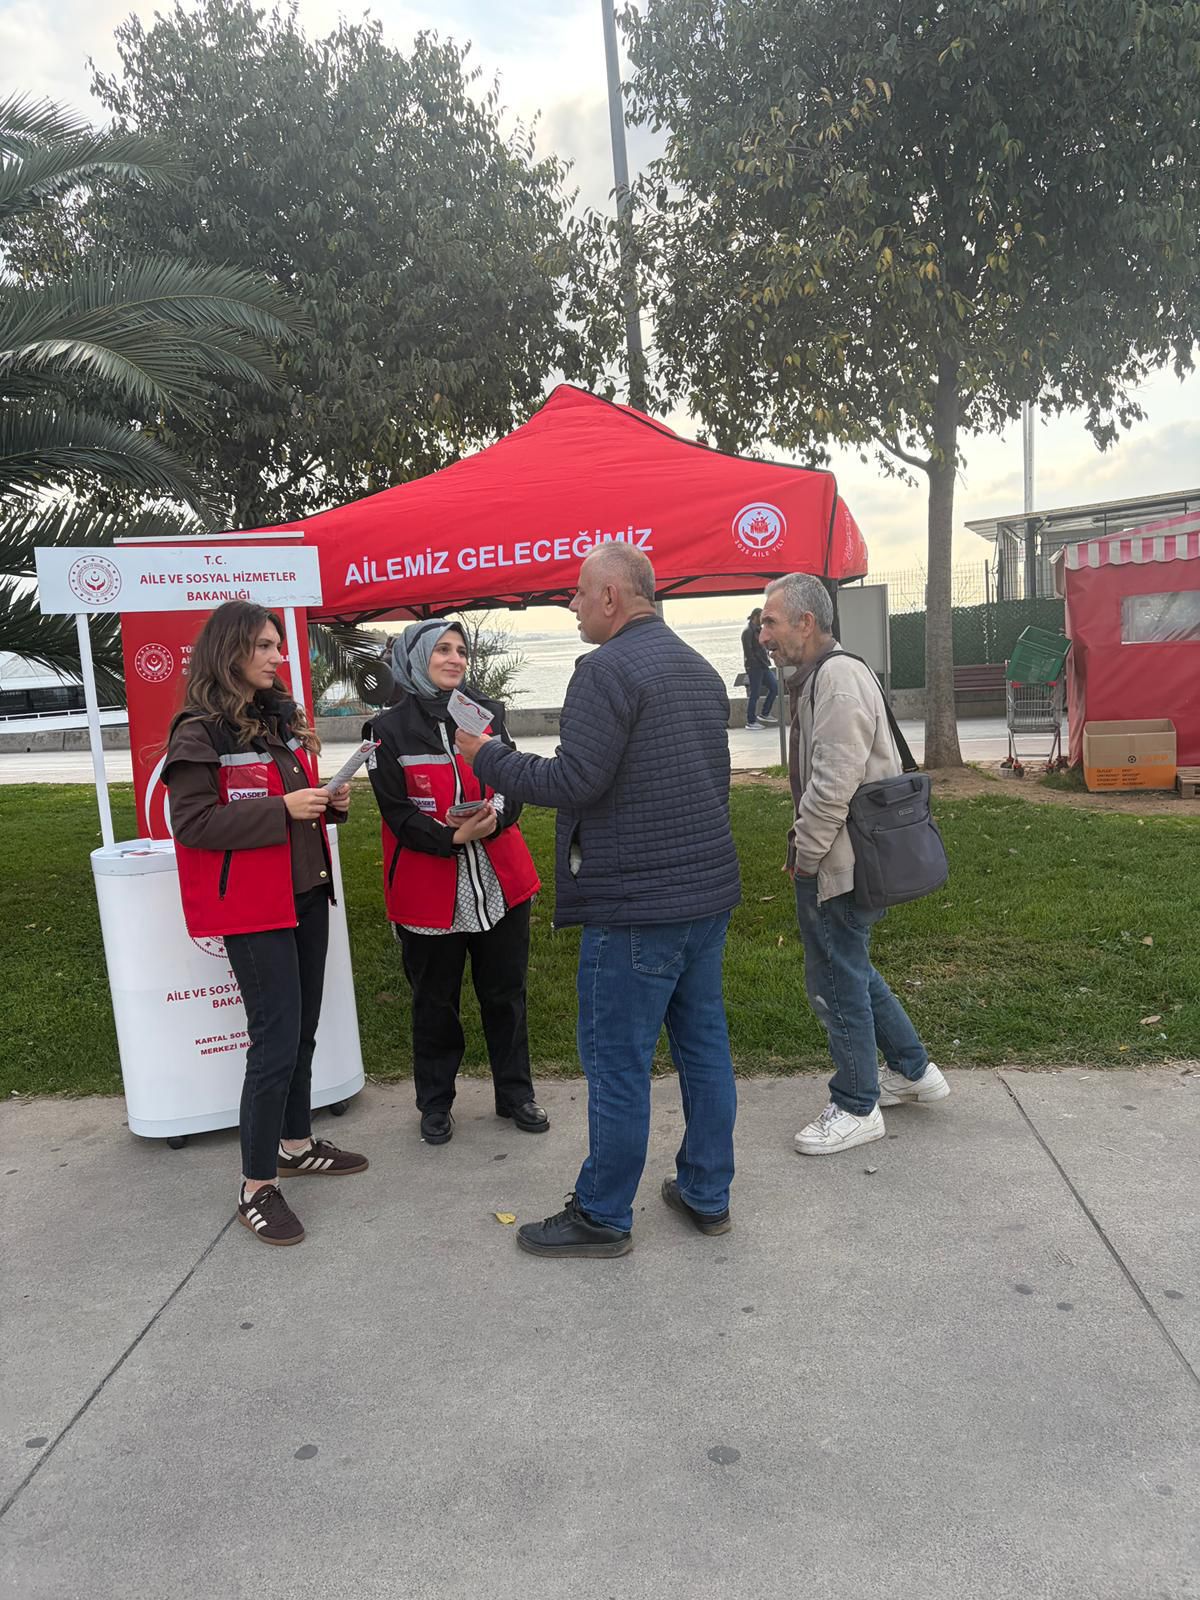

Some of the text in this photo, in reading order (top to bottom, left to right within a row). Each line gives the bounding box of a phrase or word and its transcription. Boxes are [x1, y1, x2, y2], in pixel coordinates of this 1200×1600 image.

[203, 555, 227, 565] T.C.
[344, 547, 450, 587] AİLEMİZ
[140, 570, 297, 584] AİLE VE SOSYAL HİZMETLER
[186, 588, 251, 601] BAKANLIĞI
[166, 990, 191, 1002] AİLE
[192, 988, 208, 998] VE
[195, 1034, 228, 1045] KARTAL
[200, 1043, 238, 1056] MERKEZİ
